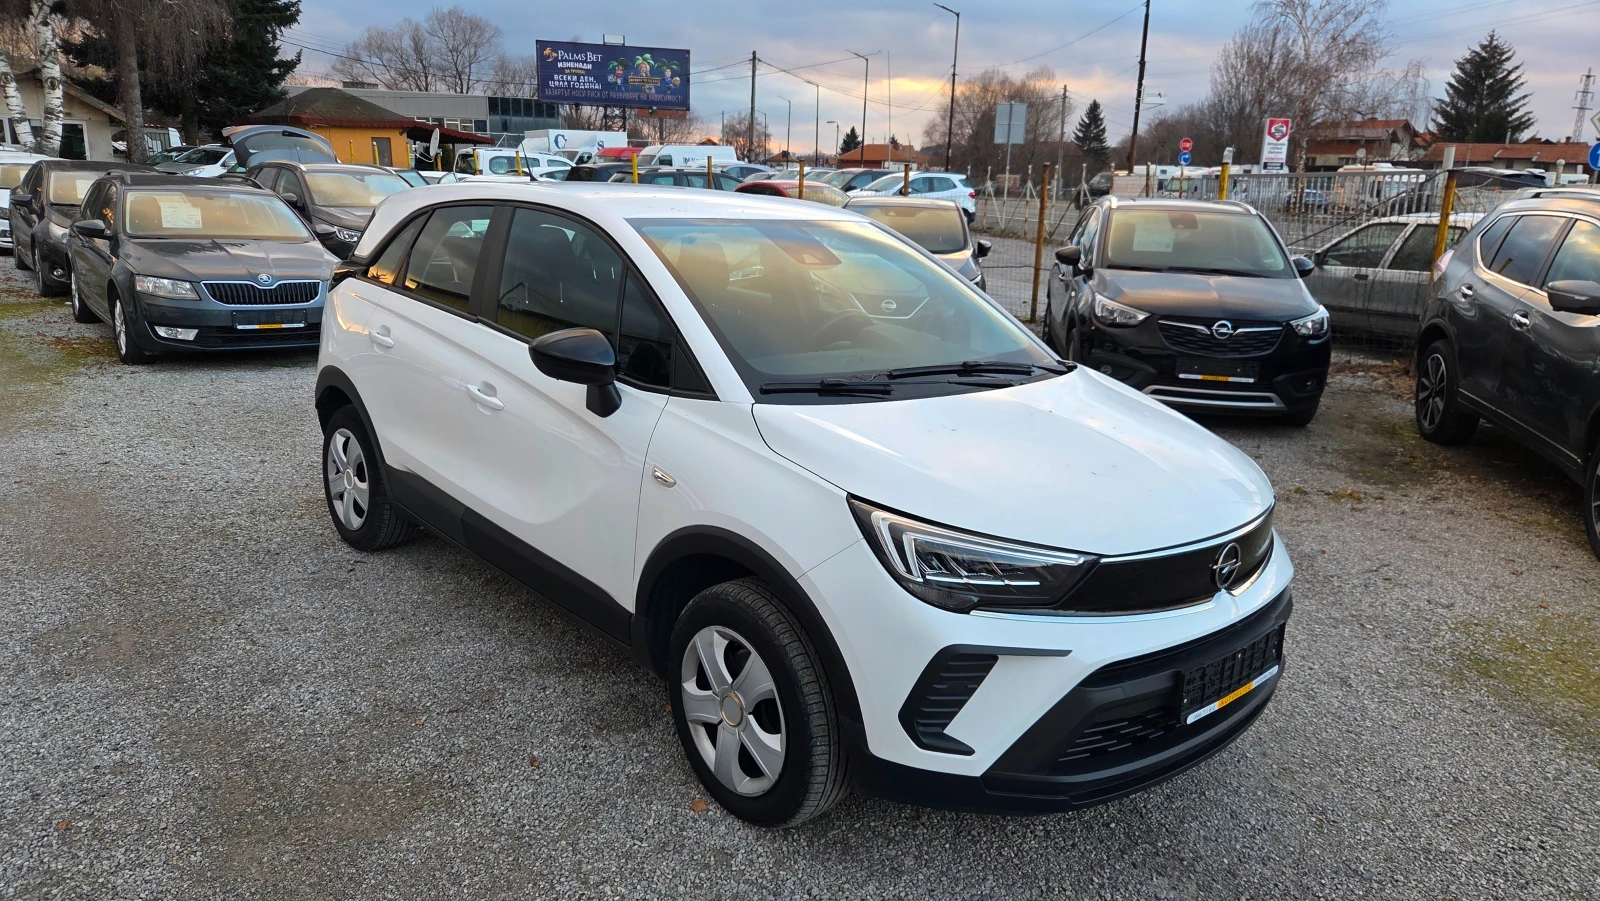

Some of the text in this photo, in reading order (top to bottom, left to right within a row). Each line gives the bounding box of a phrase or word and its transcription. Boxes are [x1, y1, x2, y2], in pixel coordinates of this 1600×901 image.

[557, 61, 593, 70] ИЗНЕНАДИ
[554, 74, 597, 84] ВСЕКИ ДЕН,
[549, 80, 602, 90] ЦЯЛА ГОДИНА!
[545, 87, 683, 103] ХАЗАРТЪТ НОСИ РИСК ОТ РАЗВИВАНЕ НА ЗАВИСИМОСТ!
[1219, 683, 1253, 706] AUTOELITE
